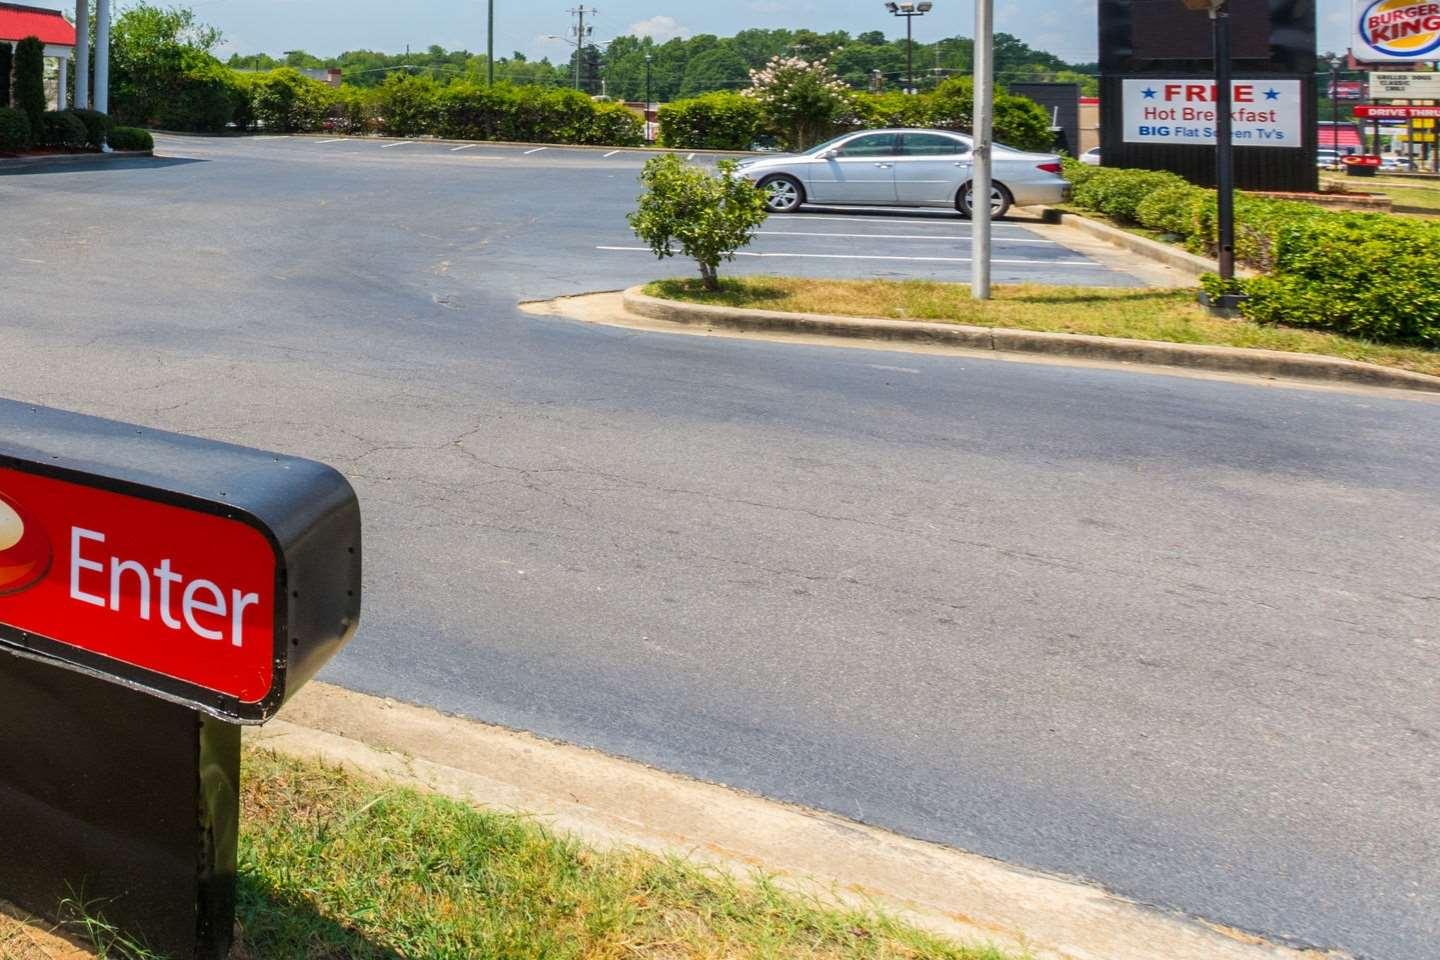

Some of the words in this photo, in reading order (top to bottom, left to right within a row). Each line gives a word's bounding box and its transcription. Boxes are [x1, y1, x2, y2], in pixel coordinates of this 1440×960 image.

[1368, 3, 1440, 30] BURGER
[1371, 16, 1440, 44] KING
[1144, 107, 1177, 120] Hot
[1182, 107, 1276, 123] Brekfast
[1368, 108, 1407, 117] DRIVE
[1139, 126, 1170, 137] BIG
[1174, 127, 1199, 138] Flat
[1256, 128, 1285, 139] Tv's
[70, 526, 259, 647] Enter
